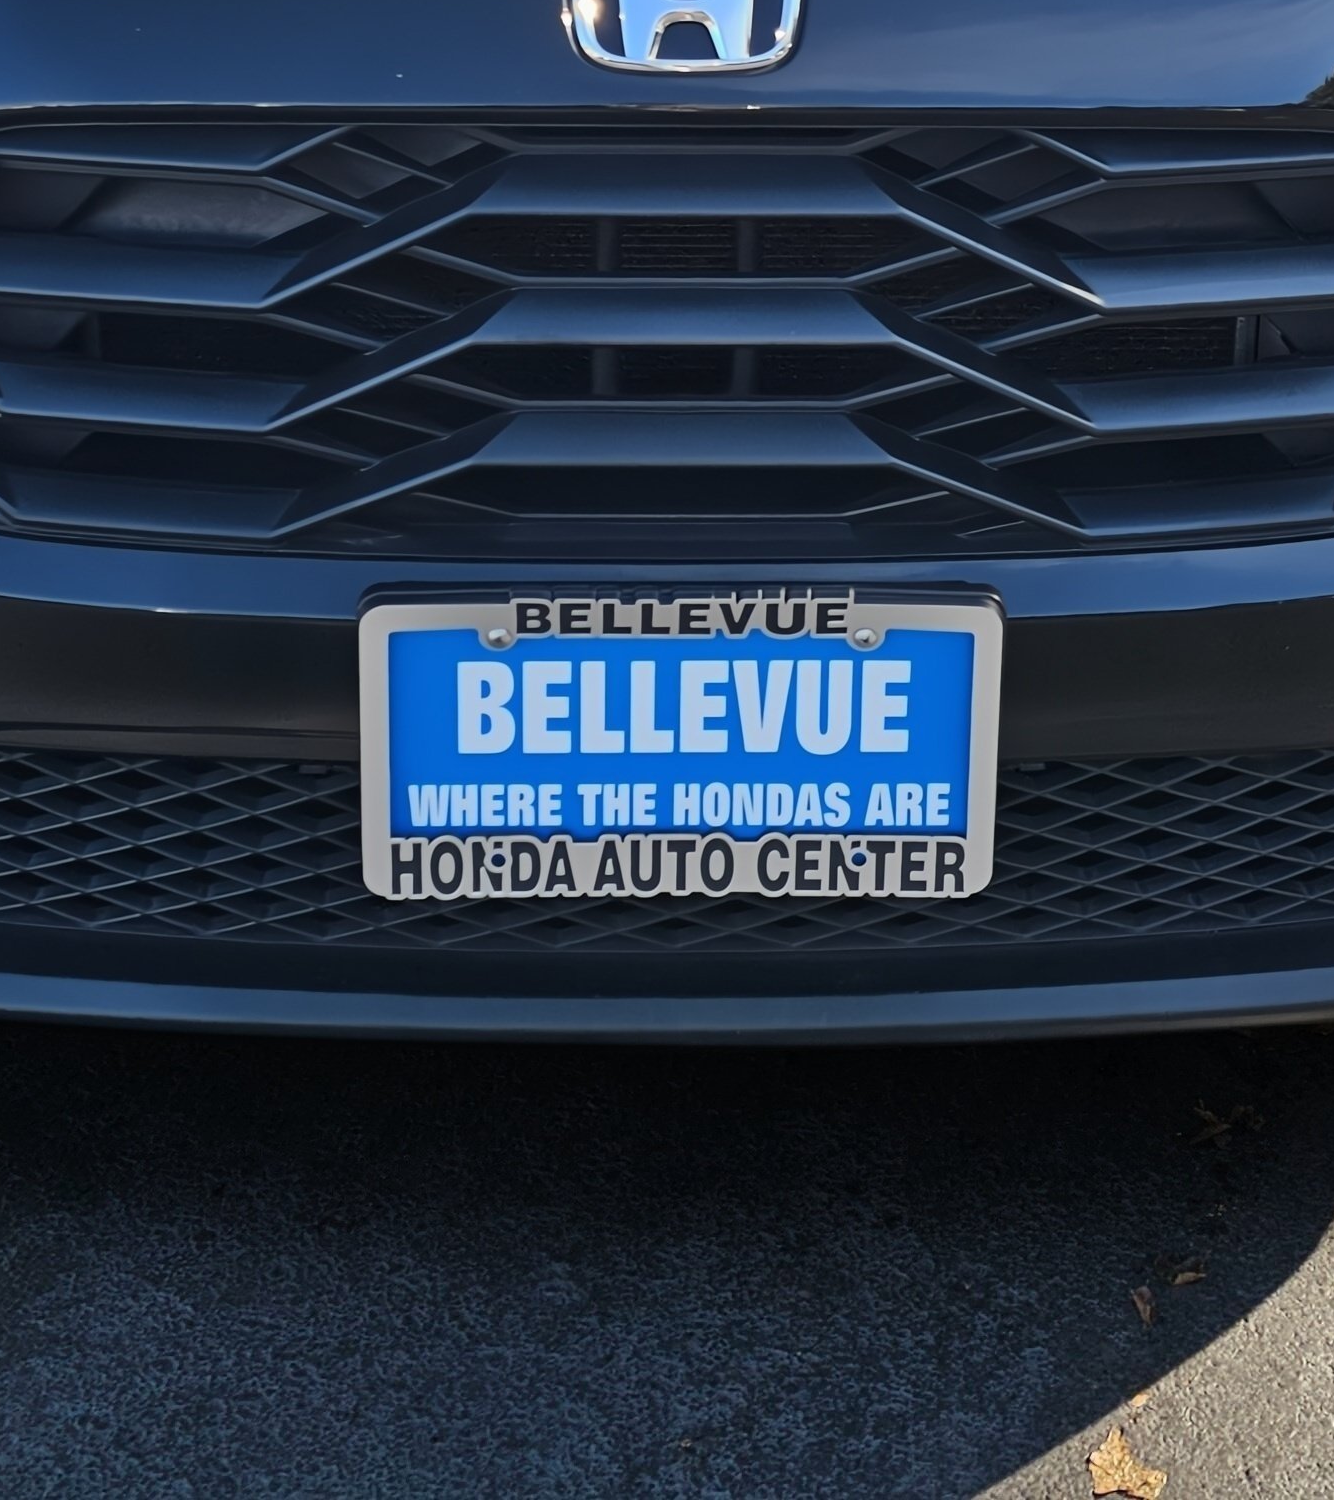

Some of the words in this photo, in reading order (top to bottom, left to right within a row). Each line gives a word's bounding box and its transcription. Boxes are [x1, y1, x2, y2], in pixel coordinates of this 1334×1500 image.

[516, 602, 849, 635] BELLEVUE
[457, 660, 912, 755] BELLEVUE
[408, 784, 563, 827] WHERE
[577, 784, 657, 827] THE
[672, 782, 851, 827] HONDAS
[864, 783, 951, 827] ARE
[391, 840, 577, 895] HONDA
[595, 839, 735, 892] AUTO
[757, 838, 965, 893] CENTER
